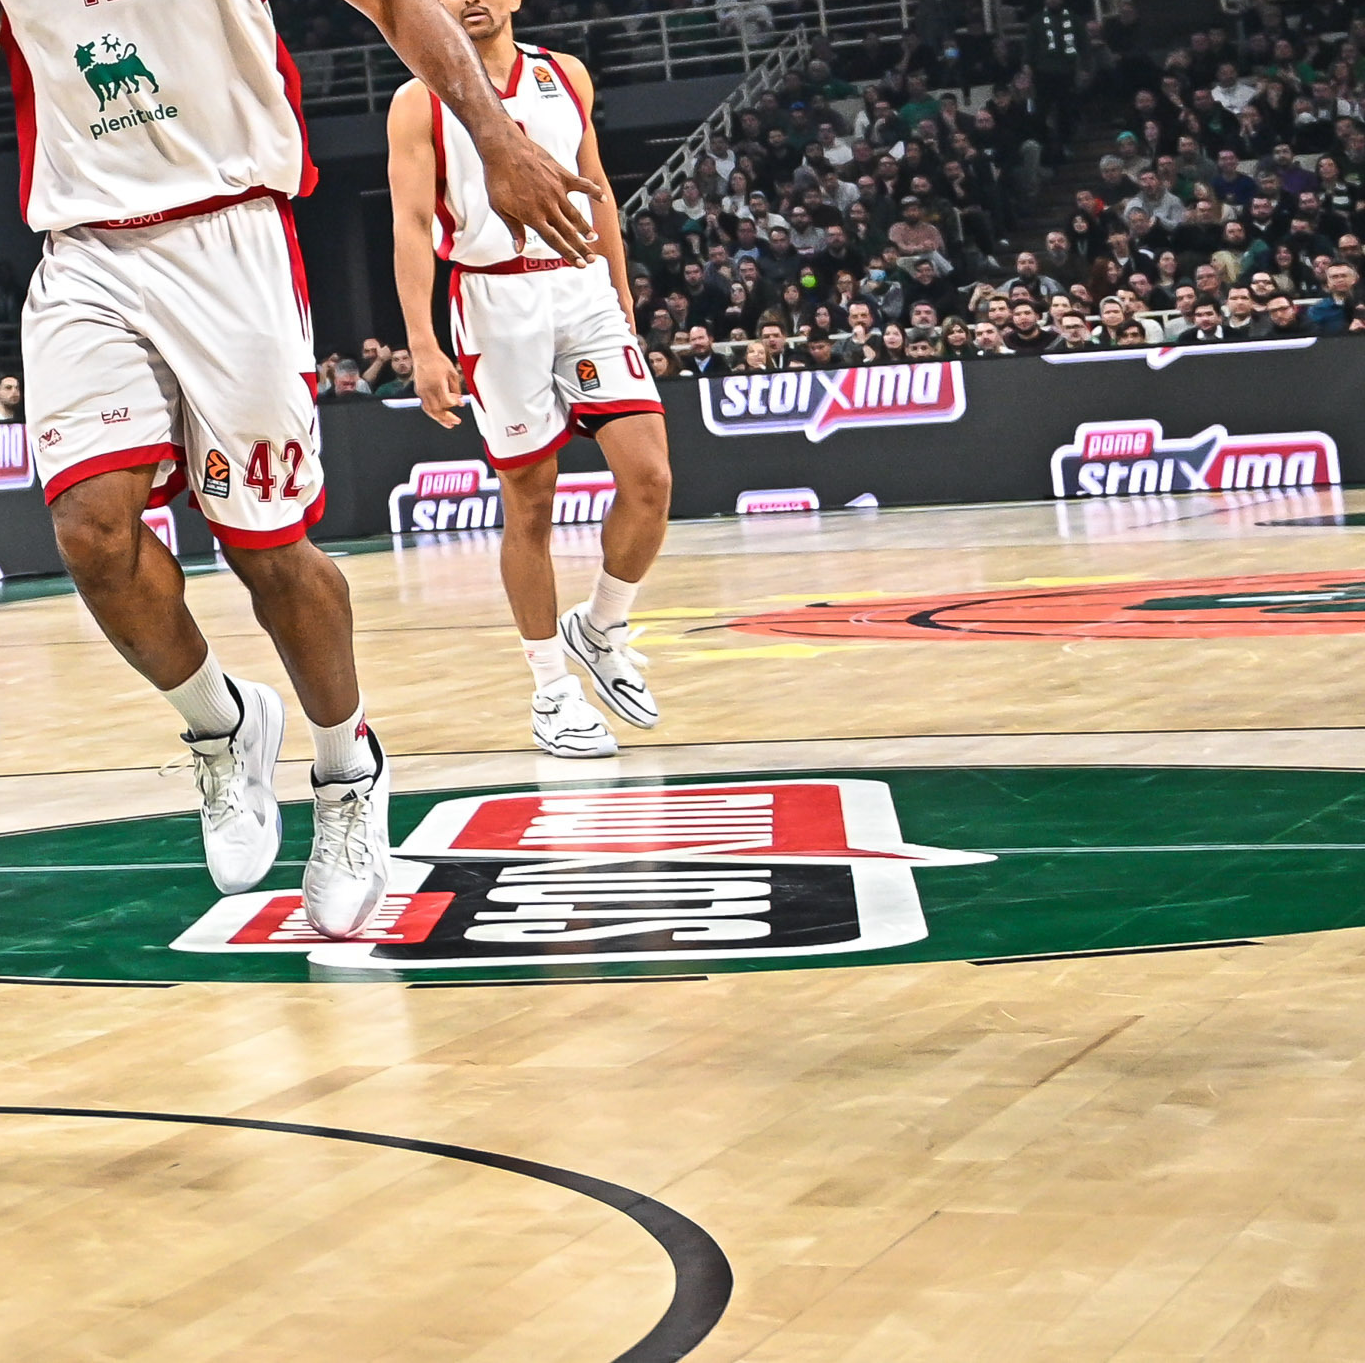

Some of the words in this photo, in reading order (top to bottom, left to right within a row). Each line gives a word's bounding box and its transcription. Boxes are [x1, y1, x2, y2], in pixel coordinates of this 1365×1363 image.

[89, 103, 178, 139] plenitude
[622, 345, 645, 379] 0
[101, 407, 129, 422] EA7
[1088, 433, 1147, 459] pame
[244, 439, 306, 502] 42
